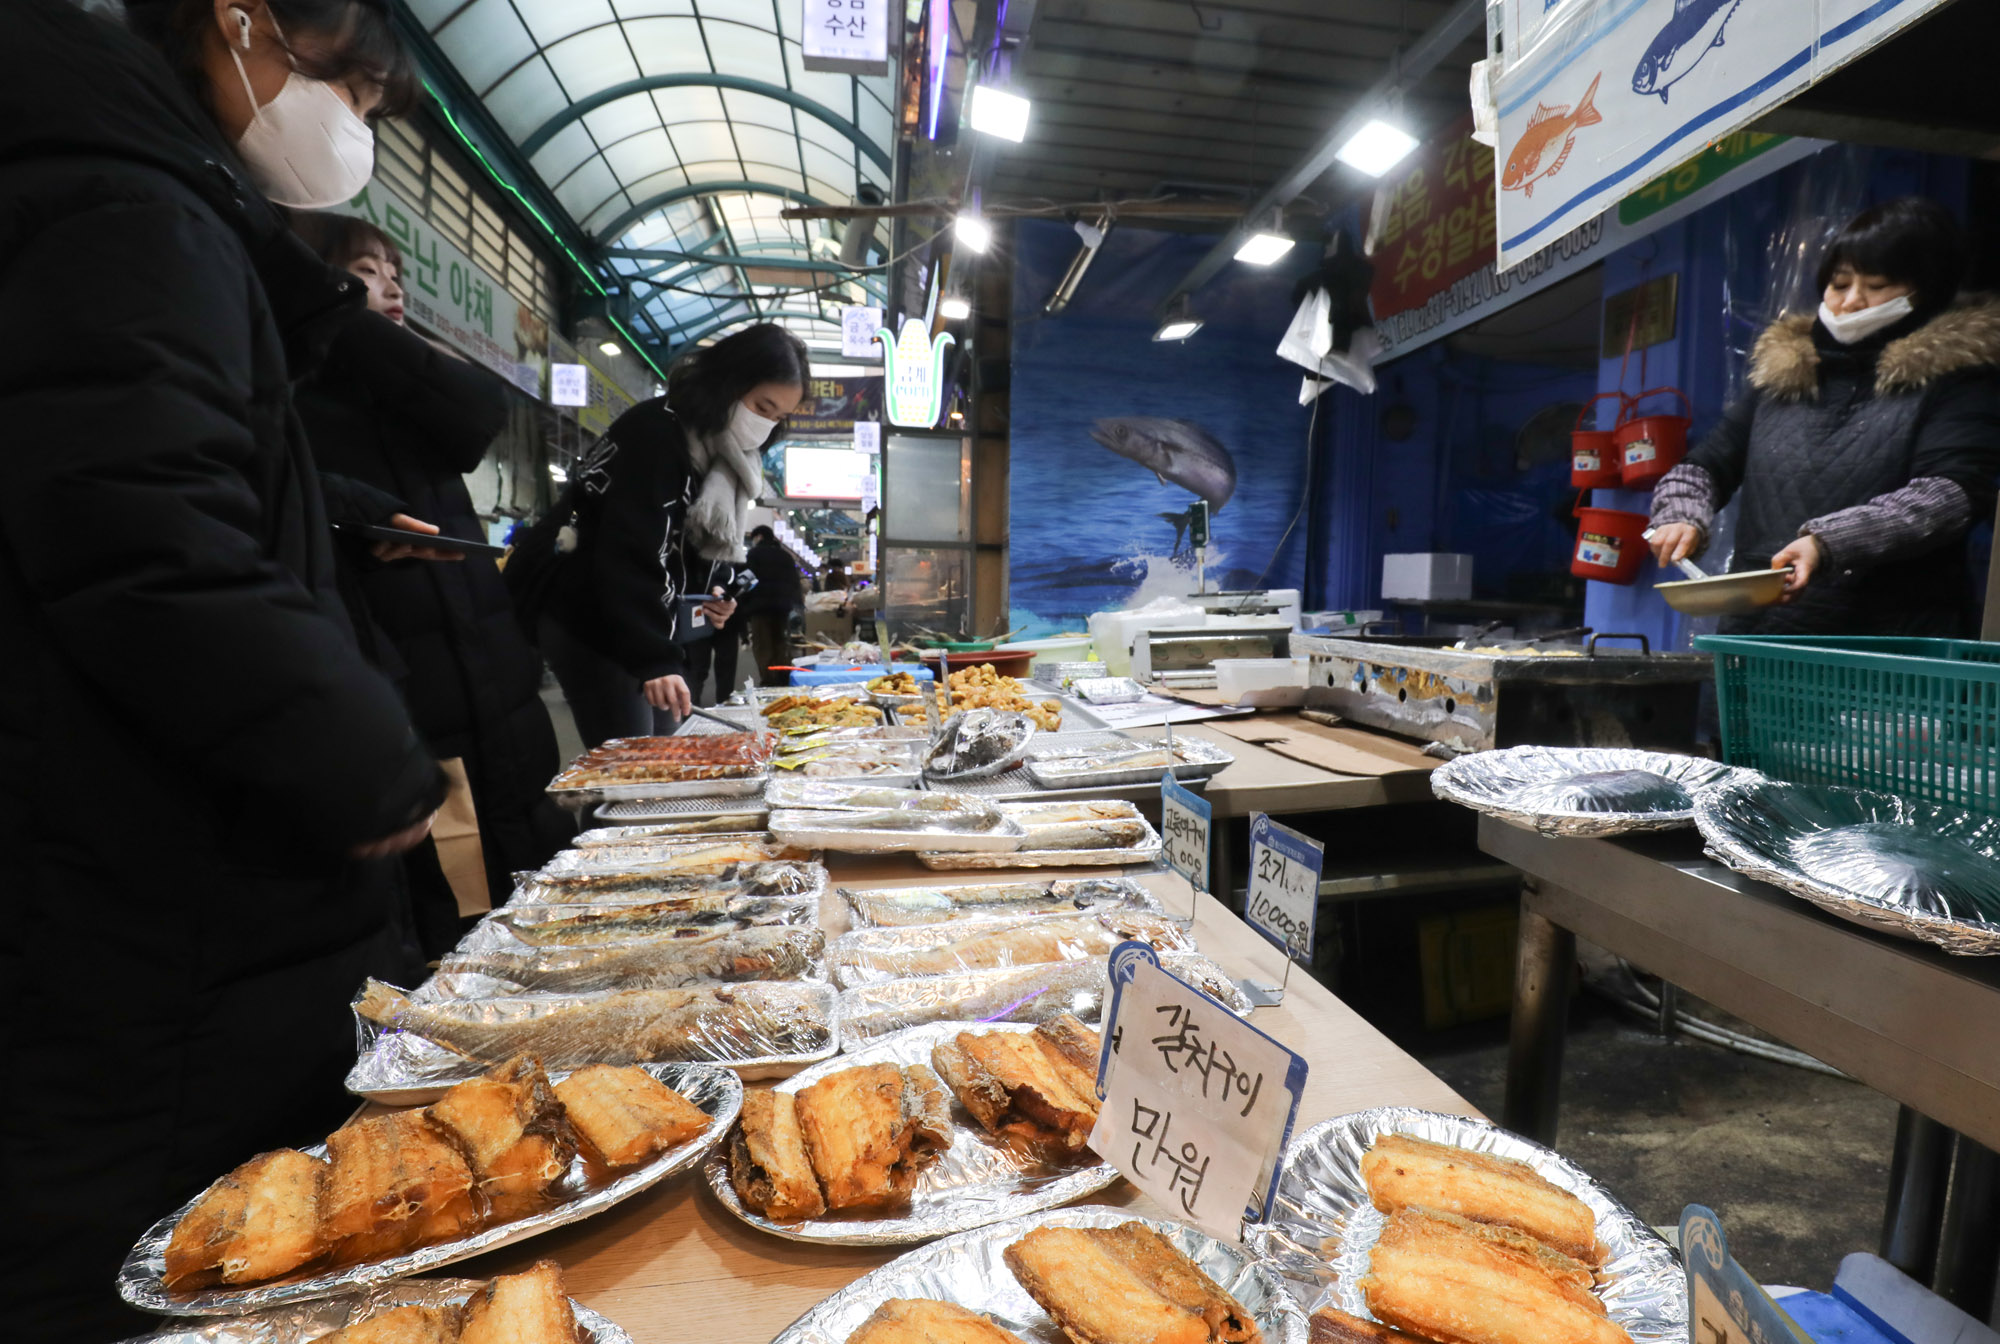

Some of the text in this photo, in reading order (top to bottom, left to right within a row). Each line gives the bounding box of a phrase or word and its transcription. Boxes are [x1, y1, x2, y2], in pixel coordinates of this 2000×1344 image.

[825, 15, 867, 38] 수산
[1393, 178, 1496, 293] 수정얼음
[449, 260, 494, 338] 야채
[1164, 807, 1206, 853] 고등어구이
[1258, 849, 1287, 888] 조기
[1152, 1004, 1263, 1118] 갈치구이
[1131, 1097, 1210, 1220] 만원
